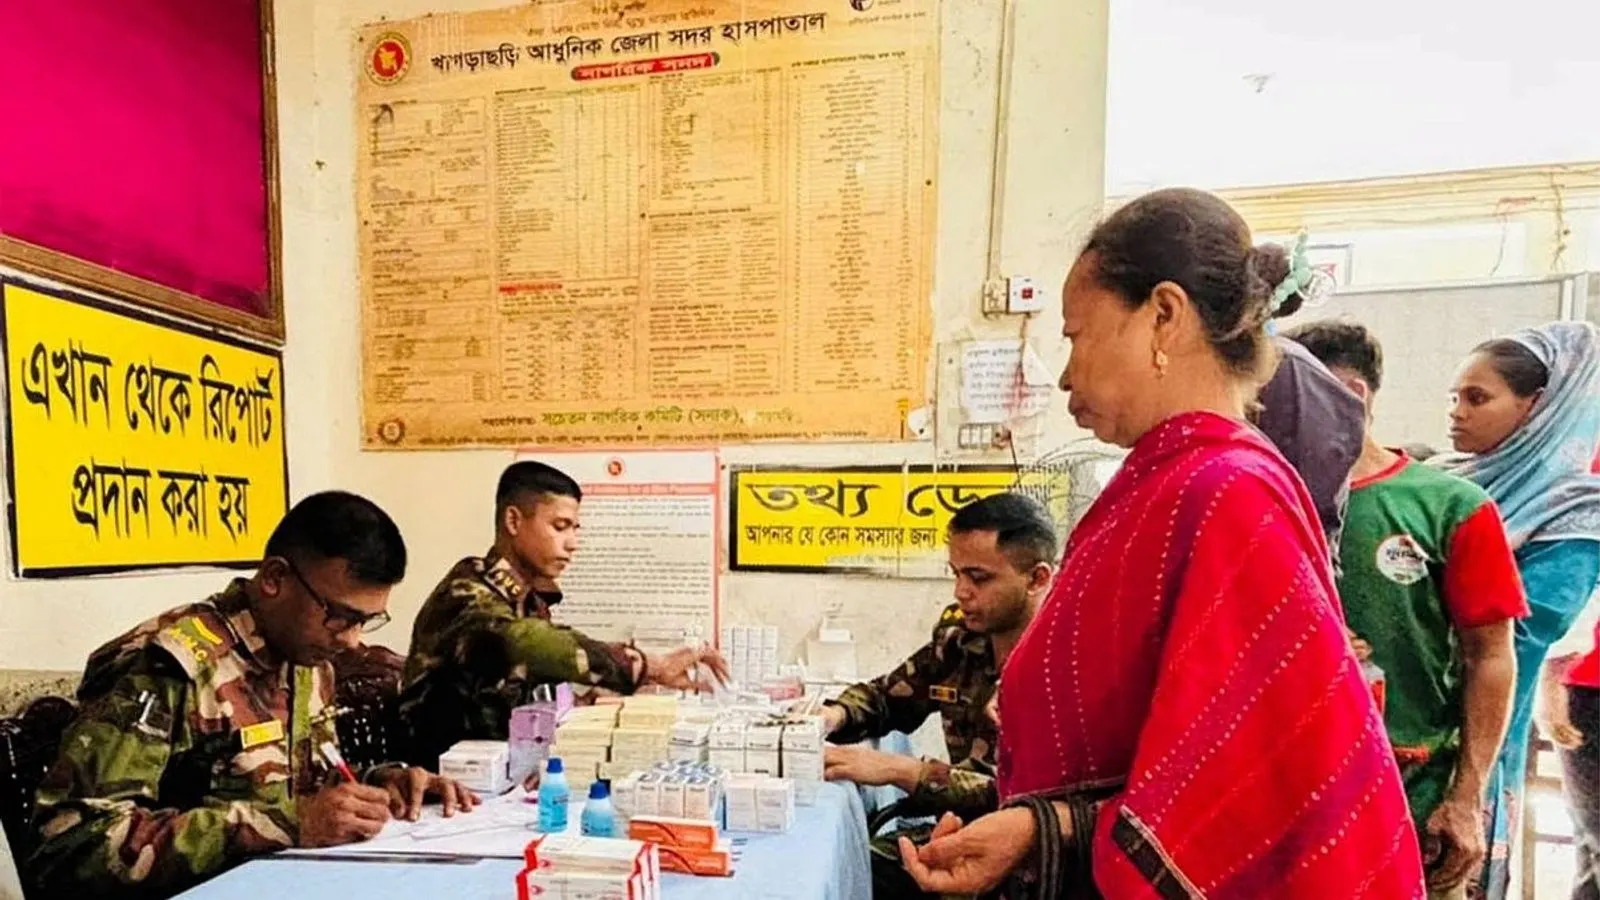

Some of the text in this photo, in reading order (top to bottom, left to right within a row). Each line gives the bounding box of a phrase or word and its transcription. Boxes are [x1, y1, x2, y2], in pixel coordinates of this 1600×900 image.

[527, 36, 603, 66] আধুনিক
[610, 32, 661, 54] জেলা
[668, 26, 713, 48] সদর
[722, 12, 827, 42] হাসপাতাল
[22, 338, 275, 448] এখান থেকে রিপোর্ট
[71, 456, 250, 545] প্রদান করা হয়
[744, 478, 882, 518] তথ্য
[744, 524, 793, 547] আপনার
[799, 525, 815, 546] যে
[818, 525, 850, 547] কোন
[855, 524, 905, 547] সমস্যার
[909, 526, 939, 549] জন্য
